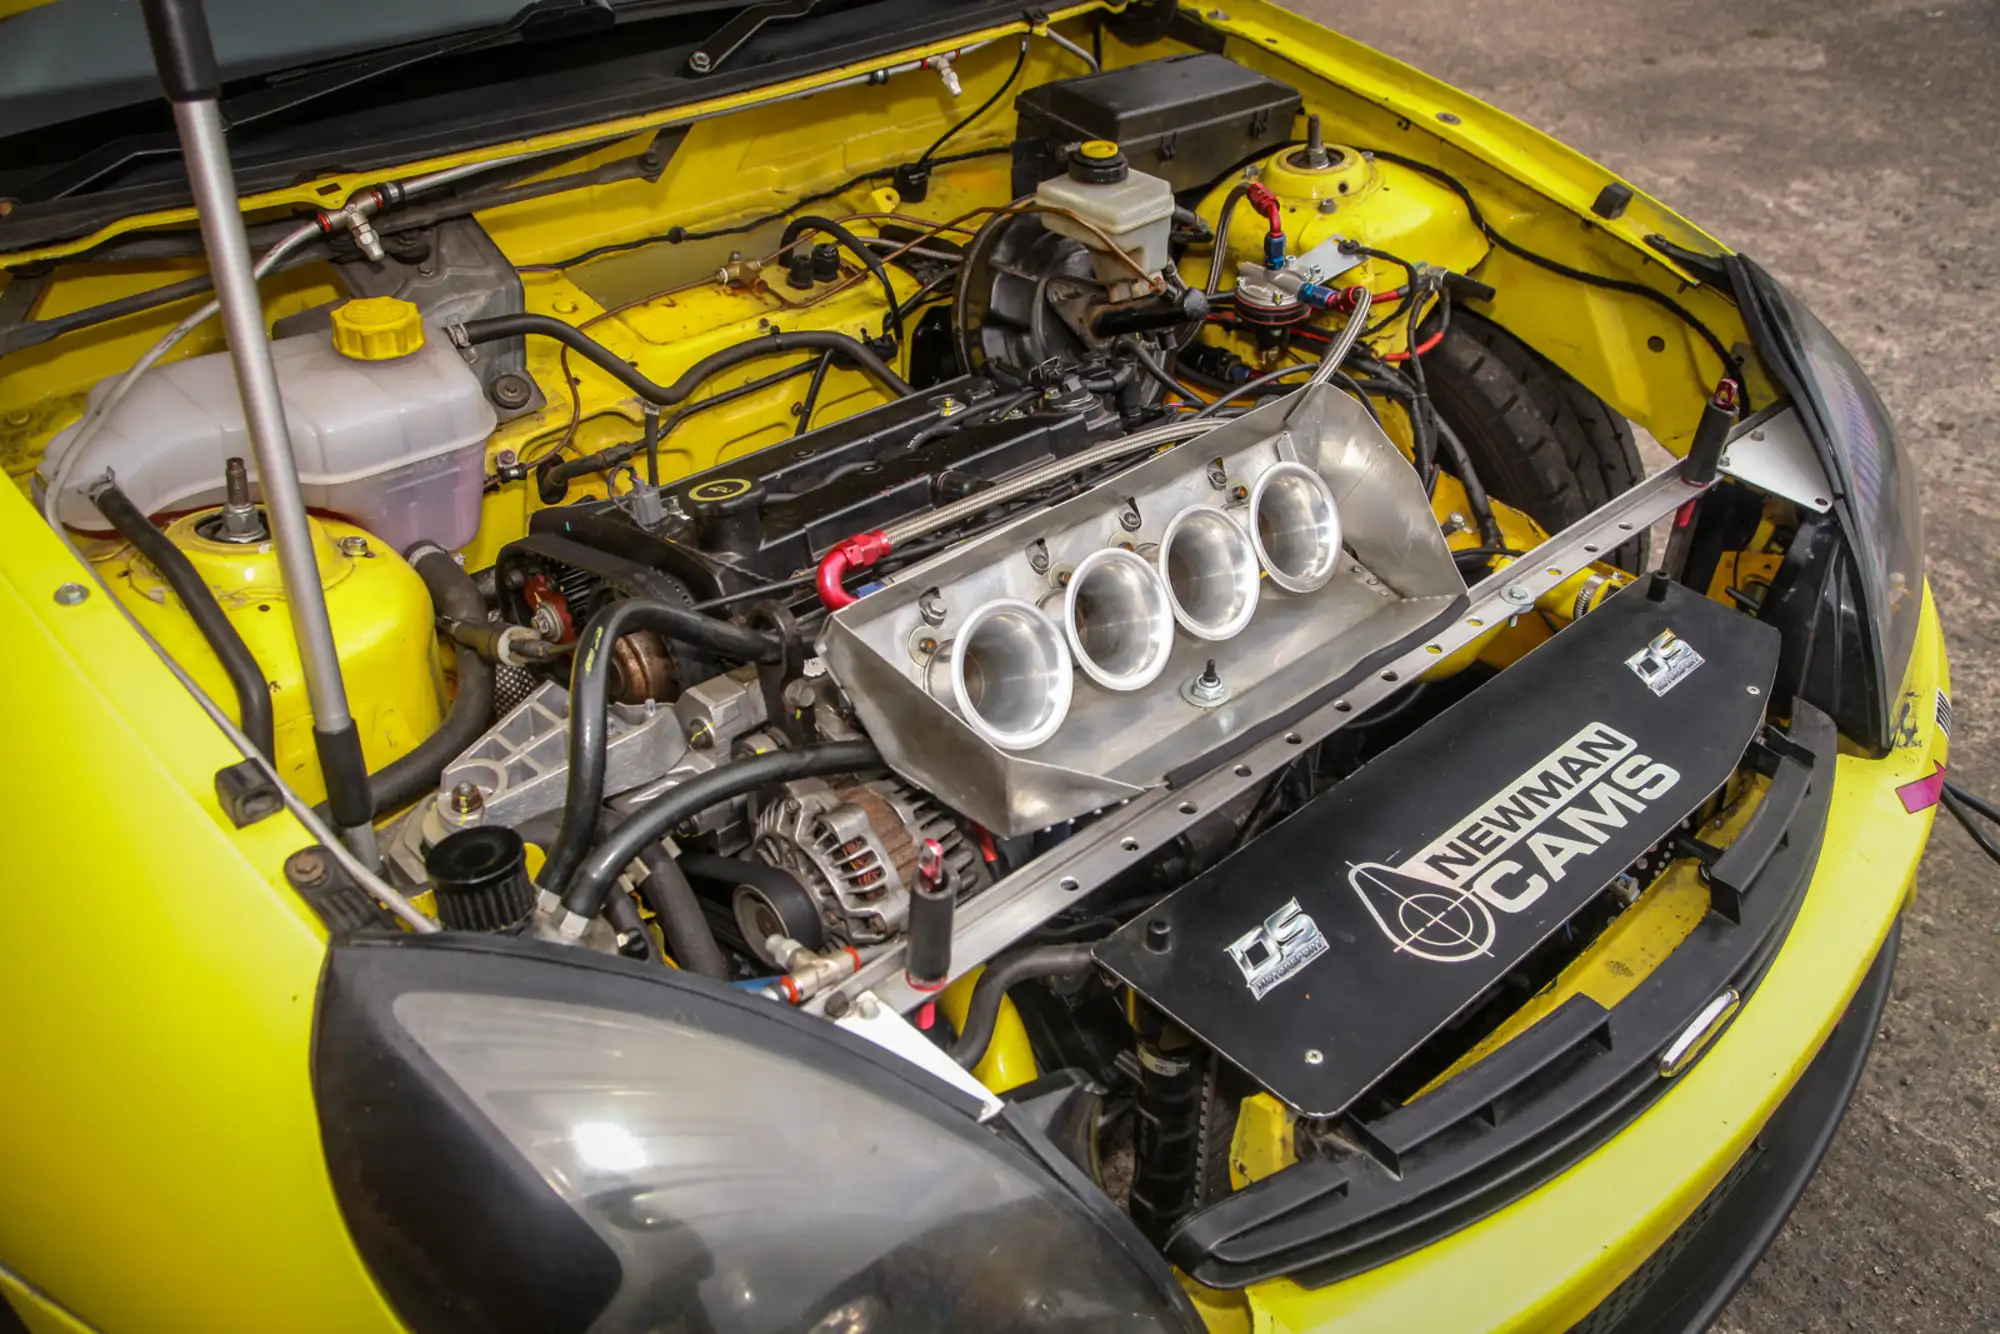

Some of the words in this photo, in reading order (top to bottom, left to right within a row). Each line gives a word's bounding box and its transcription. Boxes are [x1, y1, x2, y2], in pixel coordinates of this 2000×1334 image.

[1624, 628, 1694, 687] DS
[1423, 729, 1628, 881] NEWMAN
[1472, 754, 1681, 913] CAMS
[1223, 896, 1320, 986] DS
